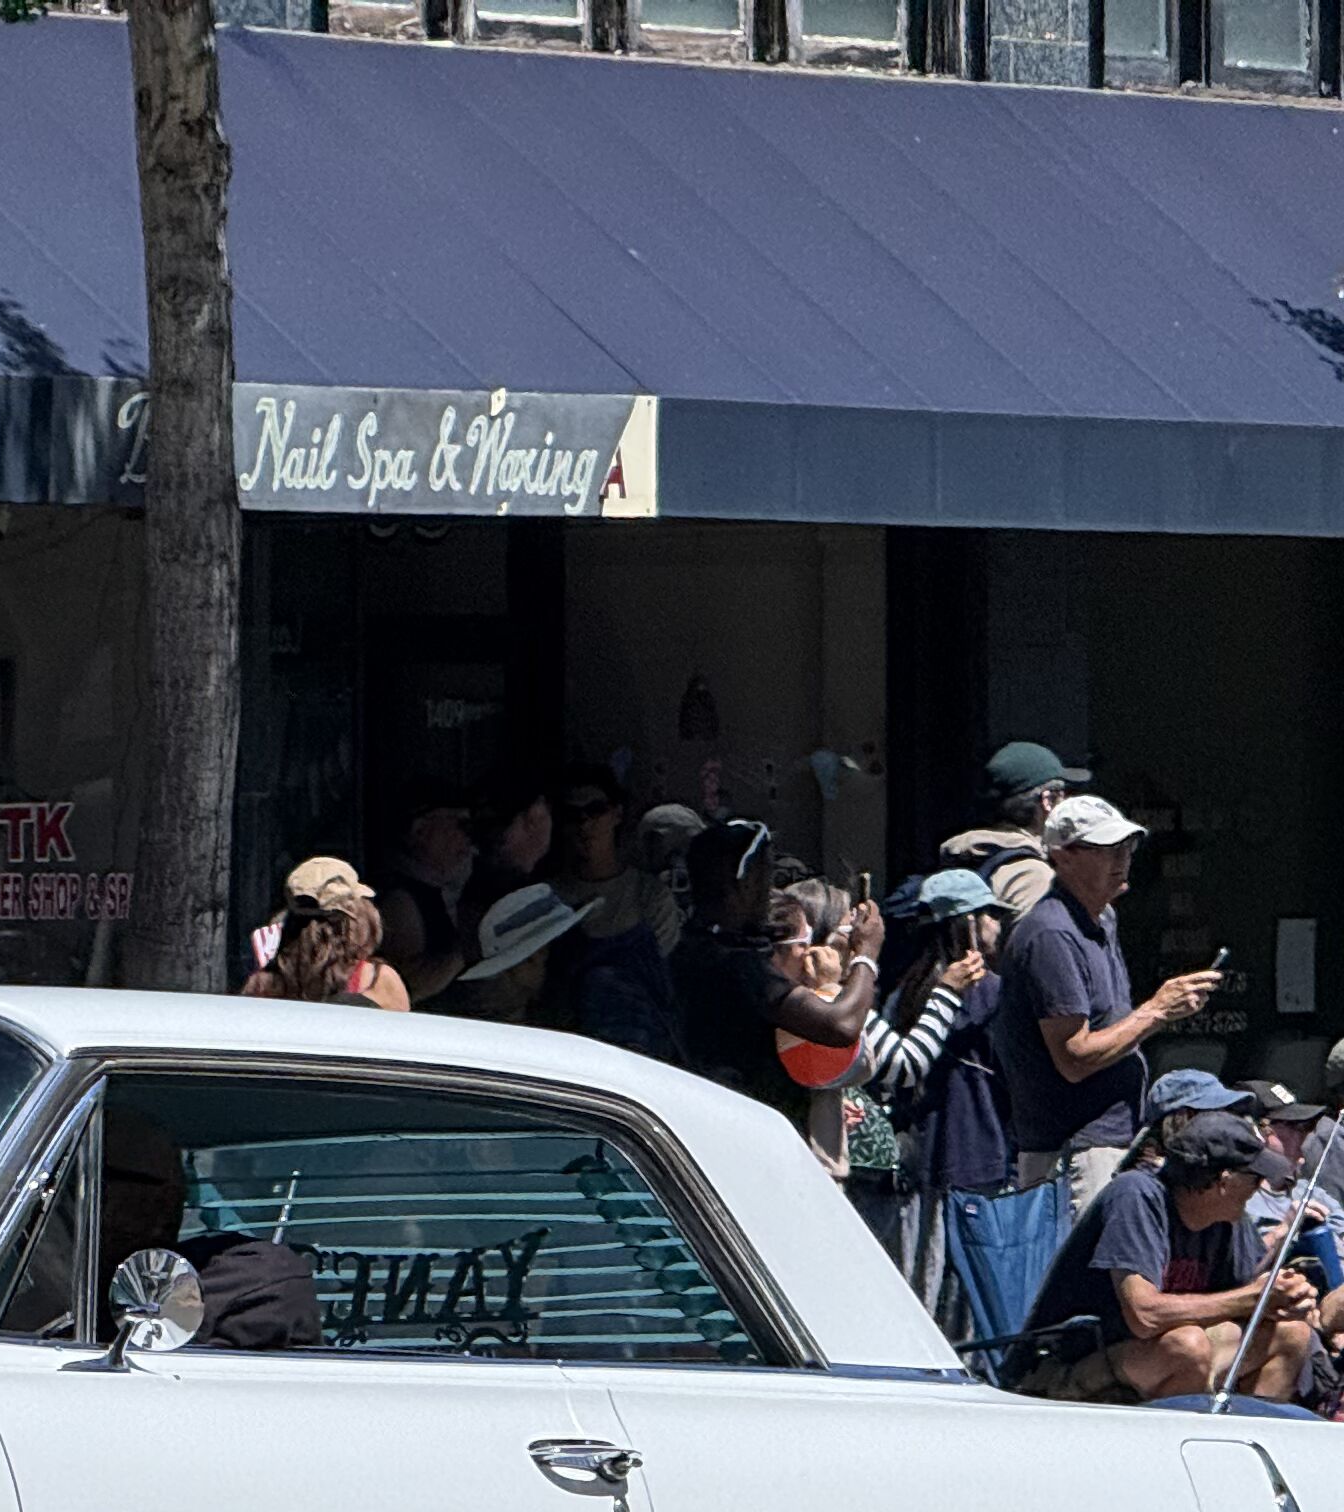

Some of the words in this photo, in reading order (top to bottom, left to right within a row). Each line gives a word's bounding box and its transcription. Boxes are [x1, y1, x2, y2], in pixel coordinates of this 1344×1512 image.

[240, 397, 341, 491] Nail
[347, 411, 417, 507] Spa
[430, 405, 462, 491] &
[466, 411, 598, 514] Waxing
[28, 873, 81, 920] SHOP
